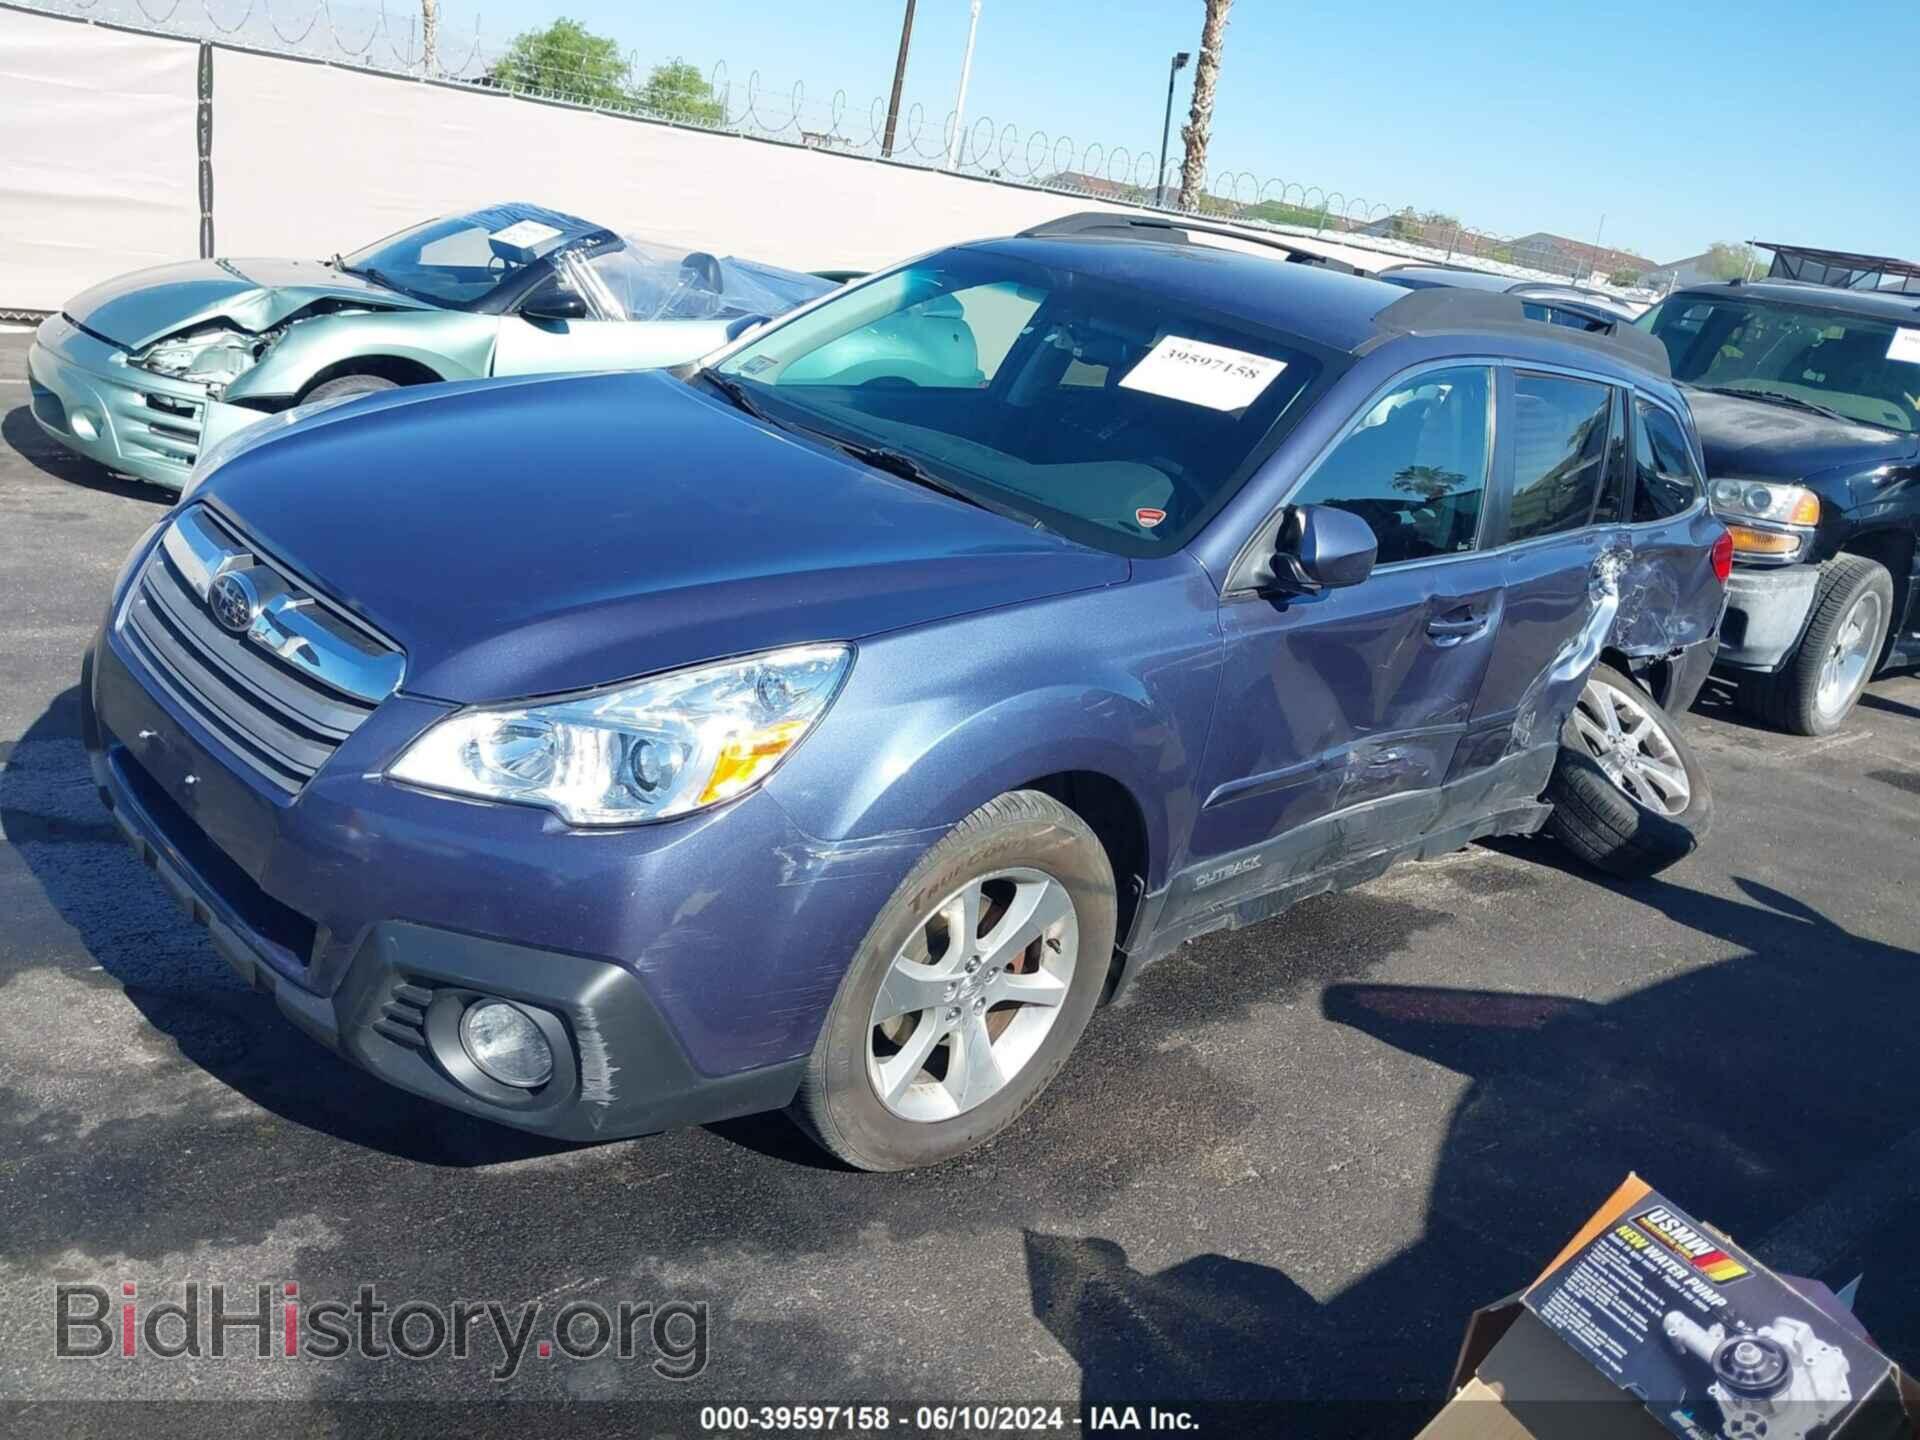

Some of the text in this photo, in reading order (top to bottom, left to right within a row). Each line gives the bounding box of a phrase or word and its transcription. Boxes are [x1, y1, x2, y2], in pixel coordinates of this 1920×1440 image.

[1161, 348, 1261, 380] 39597158
[1647, 1209, 1716, 1257] USMW
[1615, 1224, 1650, 1250] NEW
[1643, 1245, 1690, 1281] WATER
[1683, 1276, 1729, 1308] PUMP
